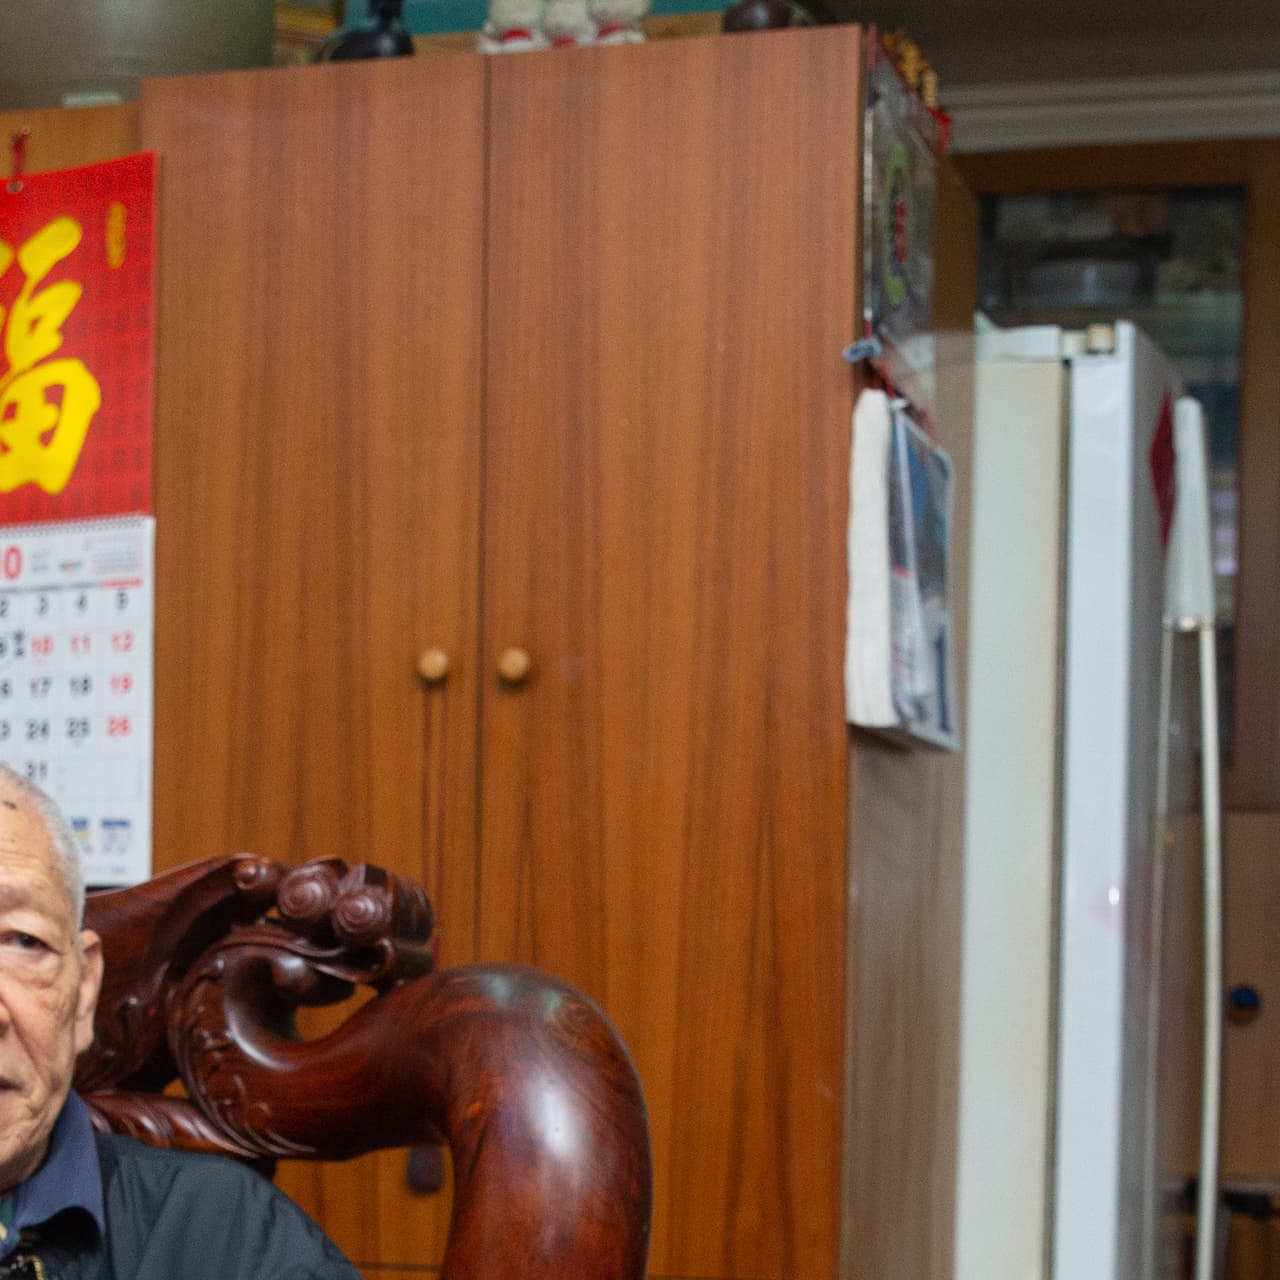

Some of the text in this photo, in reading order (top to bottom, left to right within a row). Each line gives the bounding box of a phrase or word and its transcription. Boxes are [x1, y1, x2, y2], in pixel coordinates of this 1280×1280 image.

[37, 593, 50, 616] 3
[30, 634, 54, 657] 10
[70, 632, 92, 655] 11
[111, 630, 135, 653] 12
[29, 676, 52, 698] 17
[69, 674, 92, 696] 18
[109, 672, 133, 695] 19
[26, 718, 50, 740] 24
[66, 716, 92, 739] 25
[106, 714, 133, 737] 26
